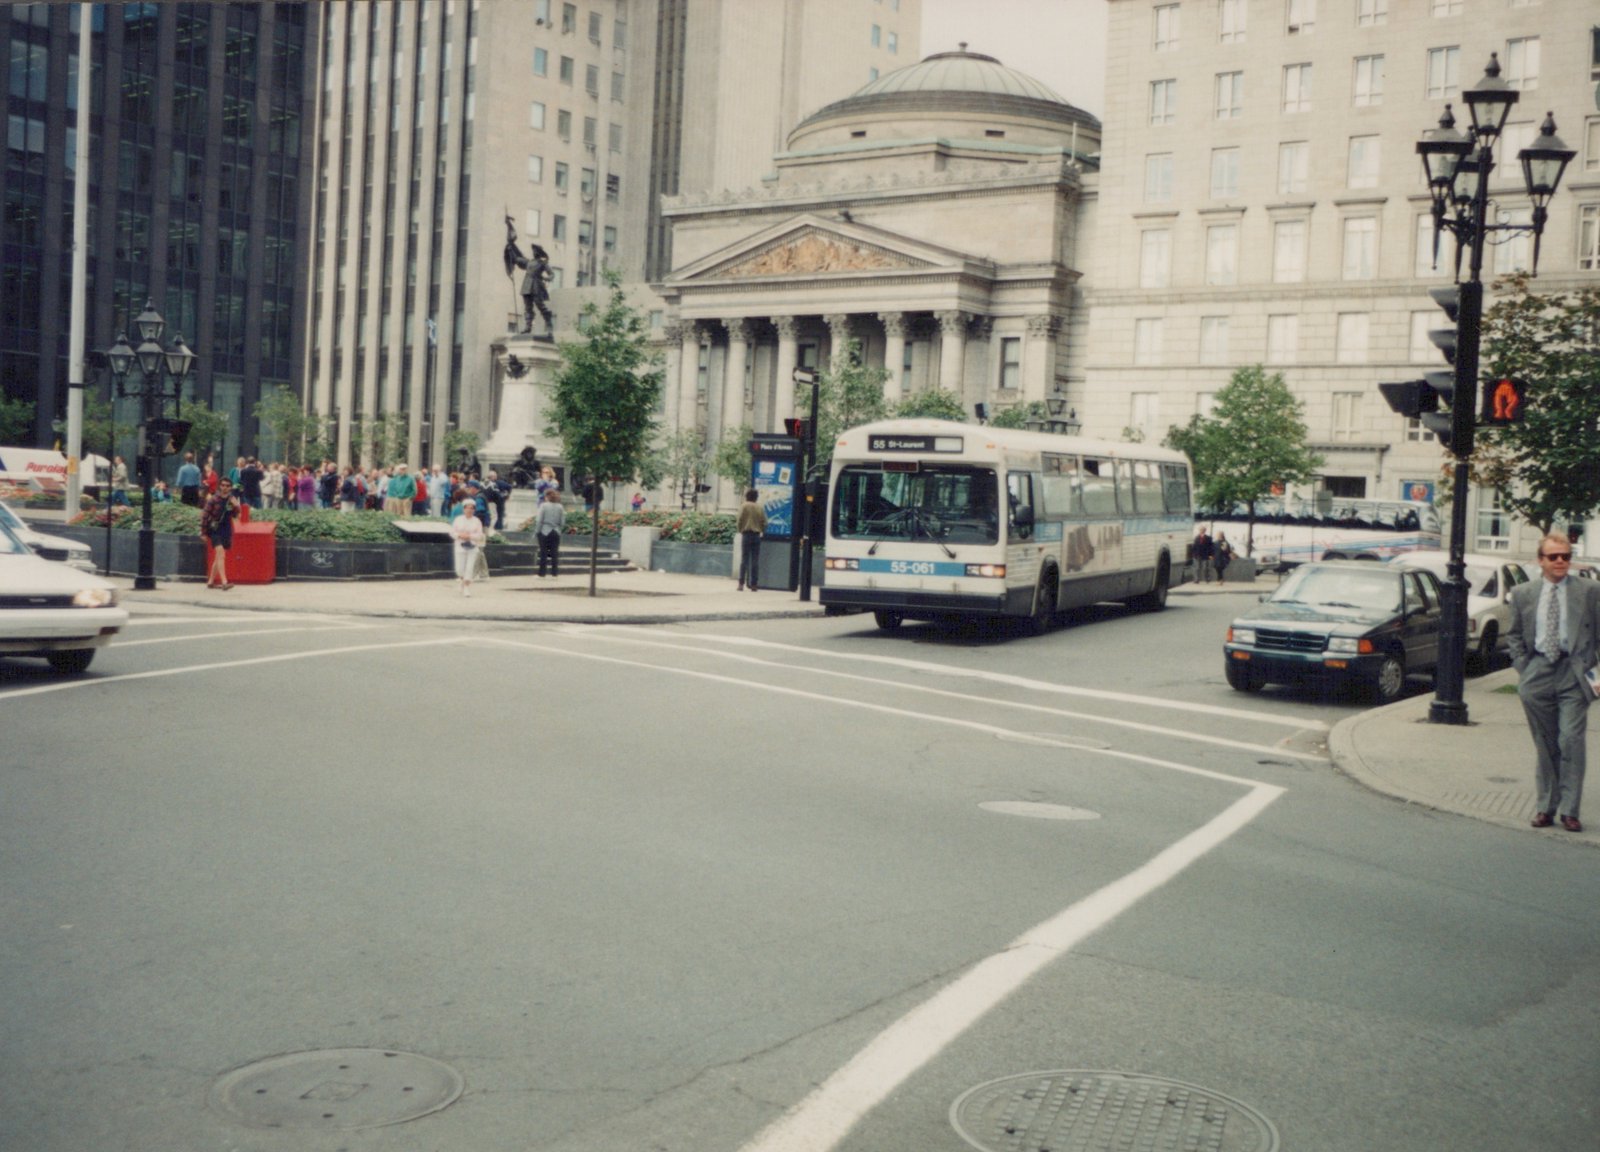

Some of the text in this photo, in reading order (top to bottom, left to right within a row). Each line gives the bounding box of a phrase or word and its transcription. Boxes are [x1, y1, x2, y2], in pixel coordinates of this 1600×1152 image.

[873, 440, 925, 449] 55 St-Laurent
[891, 561, 935, 575] 55-061
